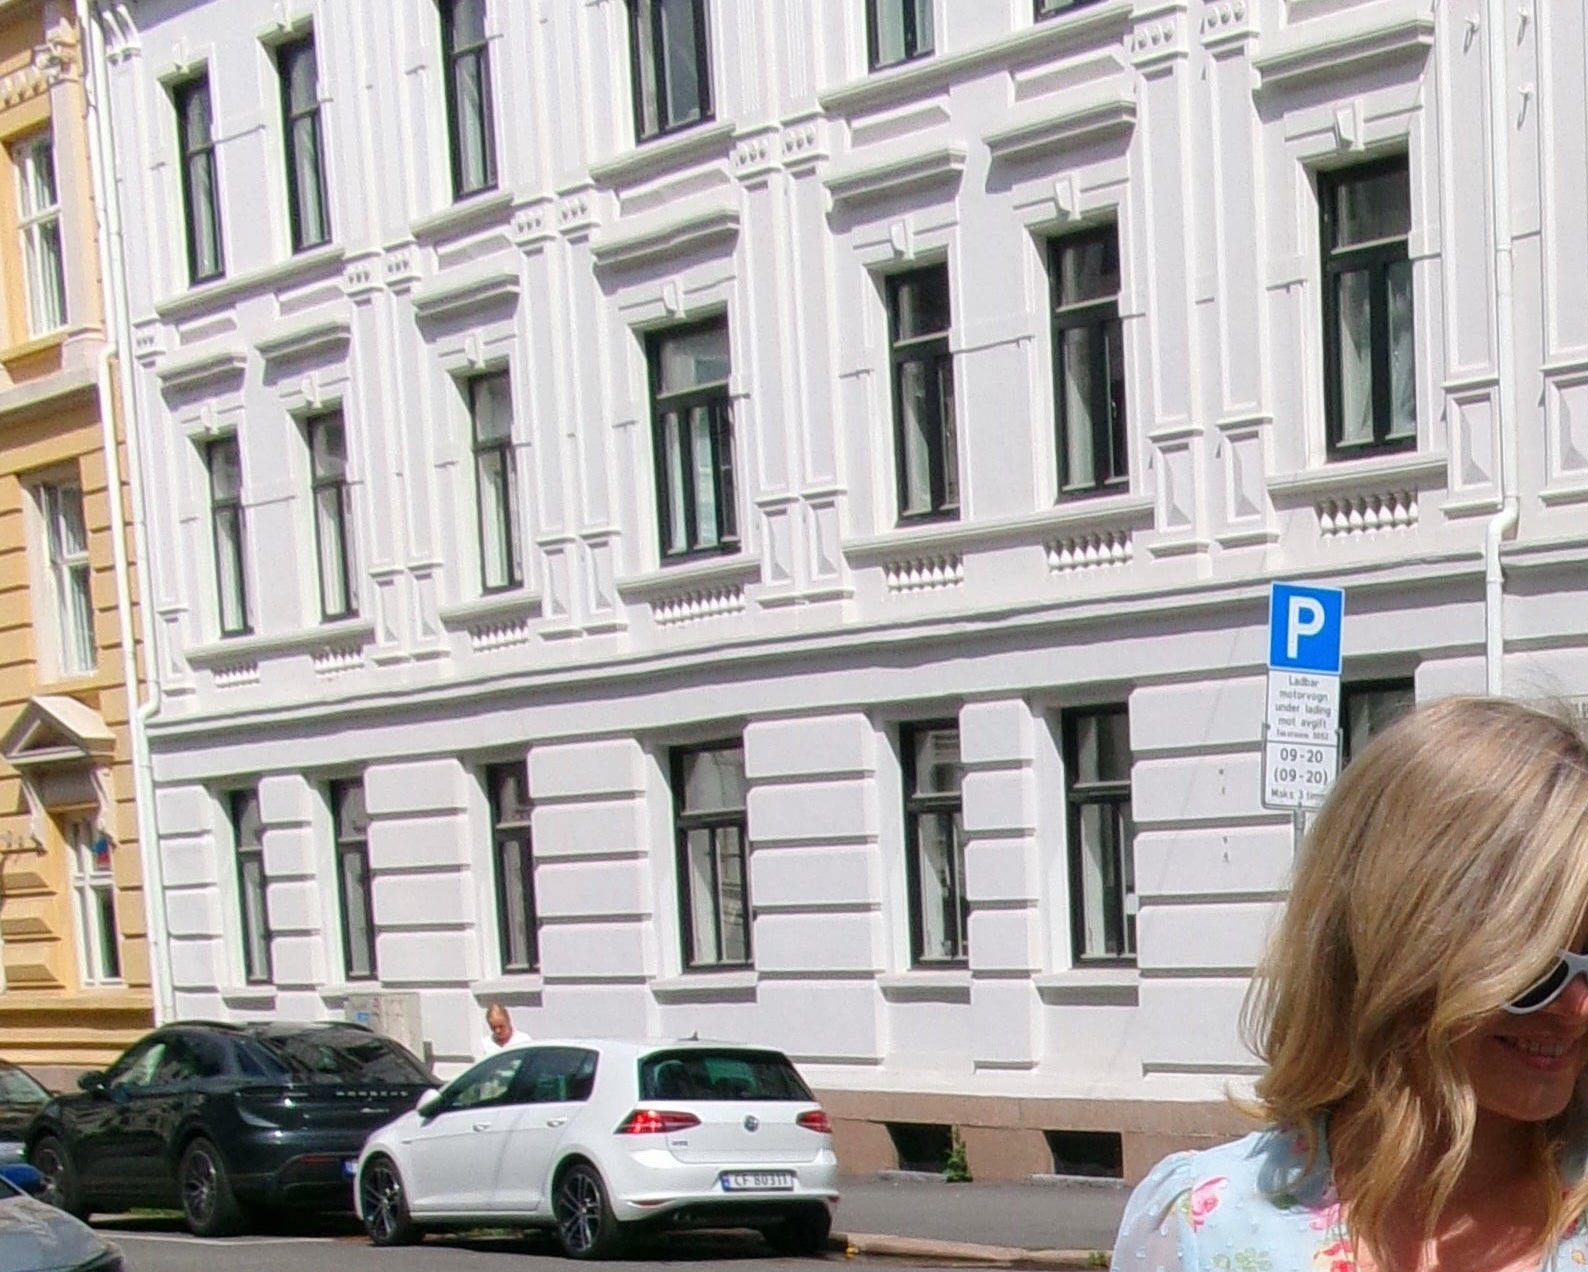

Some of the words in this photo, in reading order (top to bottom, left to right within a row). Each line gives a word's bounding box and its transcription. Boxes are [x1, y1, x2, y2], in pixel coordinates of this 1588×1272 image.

[1286, 595, 1325, 659] P
[1289, 675, 1319, 687] Ladbar
[1279, 690, 1328, 703] motorvogn
[1275, 702, 1300, 712] under
[1305, 704, 1331, 718] lading
[1278, 717, 1295, 726] mot
[1301, 718, 1326, 731] avgift
[1271, 788, 1294, 799] Maks
